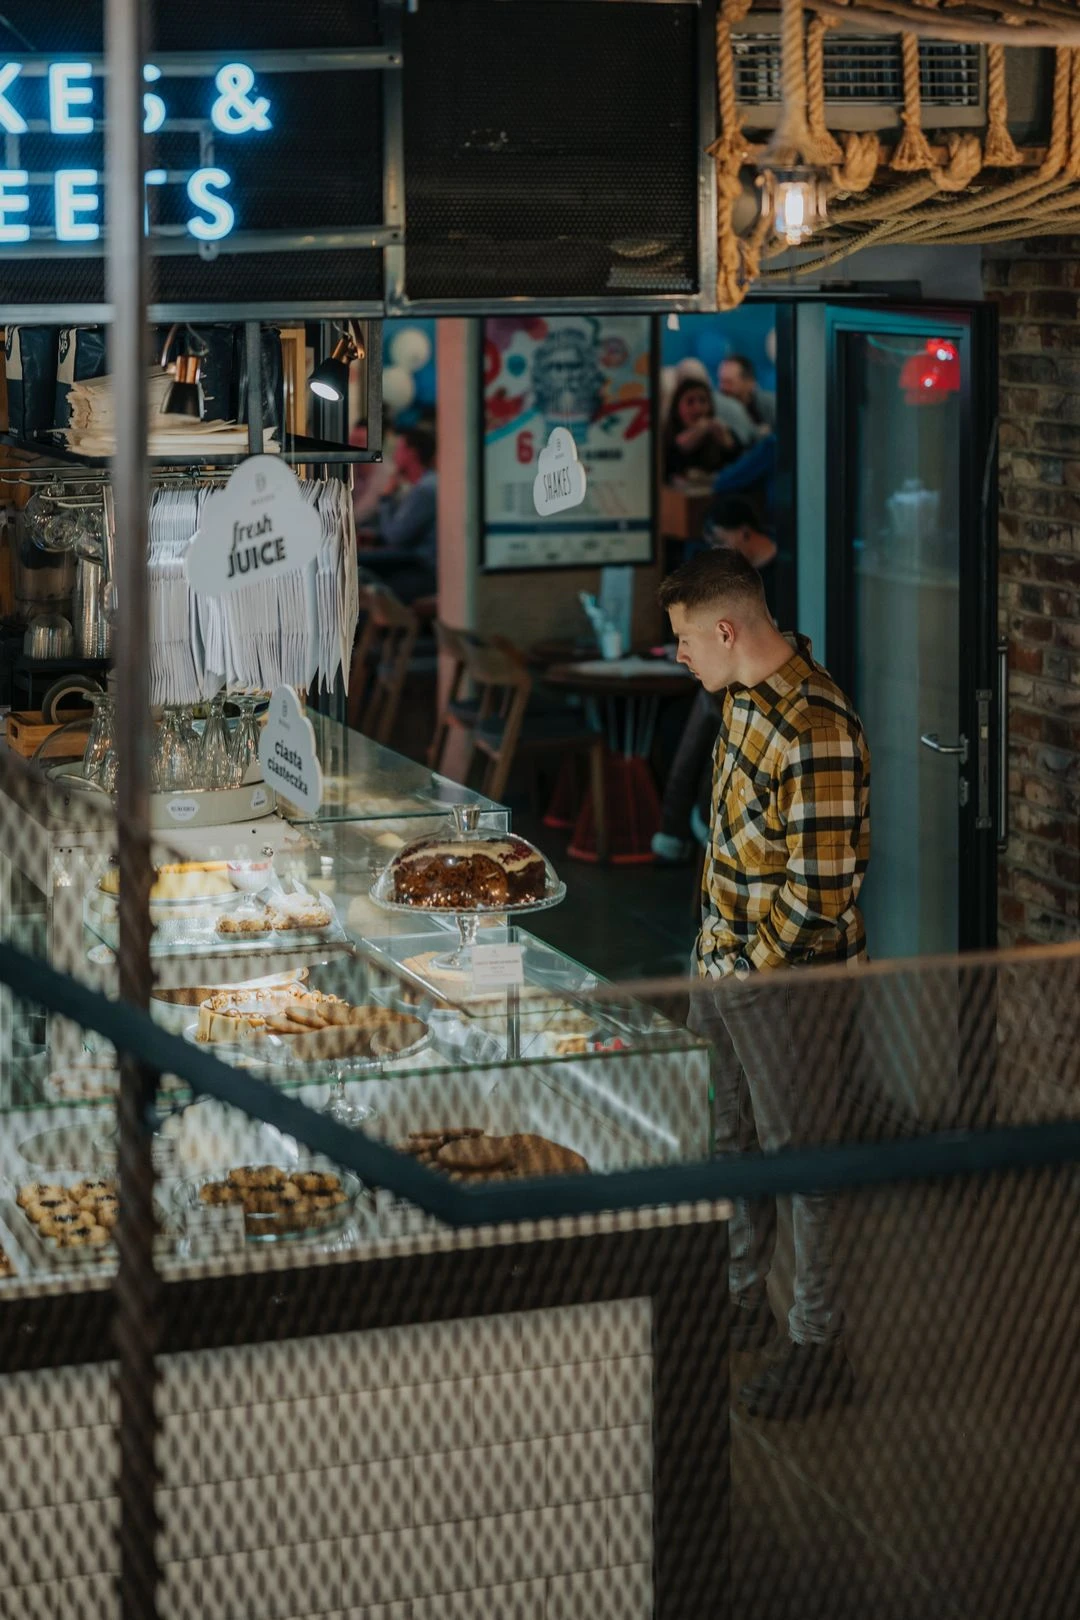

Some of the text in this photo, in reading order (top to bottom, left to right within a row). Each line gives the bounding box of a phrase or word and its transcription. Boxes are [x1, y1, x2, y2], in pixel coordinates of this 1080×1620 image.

[211, 63, 272, 134] &
[543, 466, 572, 503] SHAKES
[231, 512, 273, 552] fresh
[227, 537, 286, 578] JUICE
[274, 740, 303, 771] ciasta
[267, 757, 308, 796] ciasteczka
